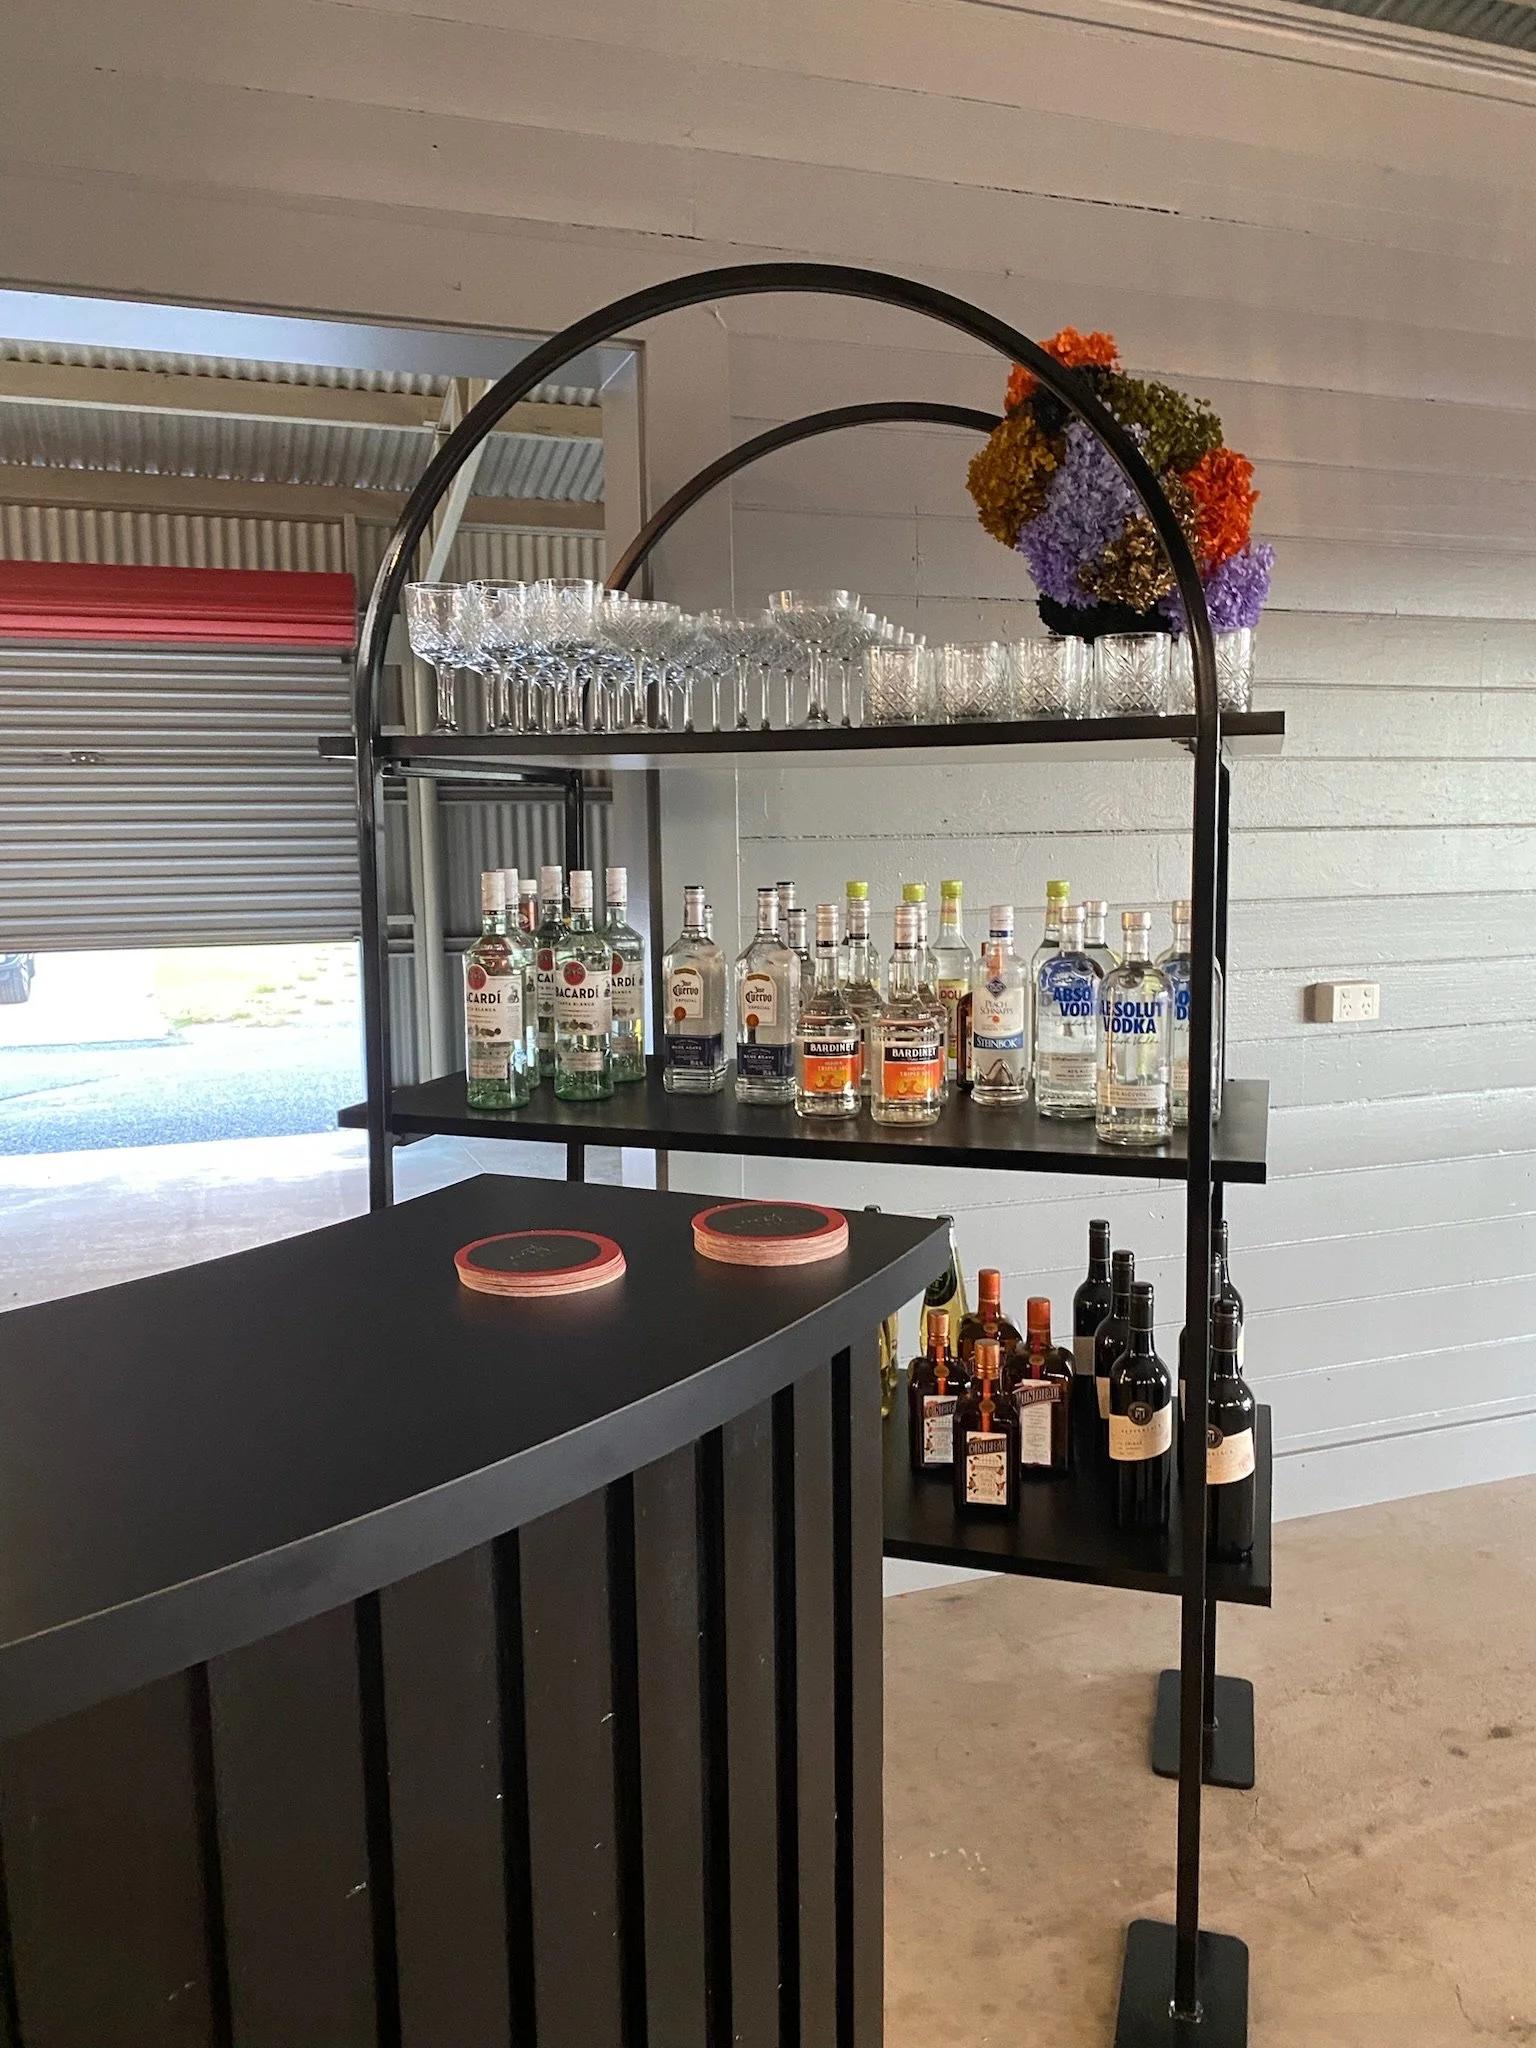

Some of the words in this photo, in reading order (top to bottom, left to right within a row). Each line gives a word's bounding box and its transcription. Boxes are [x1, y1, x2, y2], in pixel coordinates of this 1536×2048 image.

[673, 984, 699, 996] Cuervo
[468, 990, 501, 1004] CARDÍ
[745, 990, 772, 1003] Cuervo
[985, 1000, 1008, 1008] PEACH
[1099, 1000, 1164, 1018] ABSOLUT
[980, 1006, 1014, 1015] SCHNAPPS
[1103, 1015, 1157, 1034] VODKA
[810, 1042, 855, 1052] BARDINET
[976, 1036, 1018, 1049] STEINBOK
[892, 1047, 936, 1057] BARDINET
